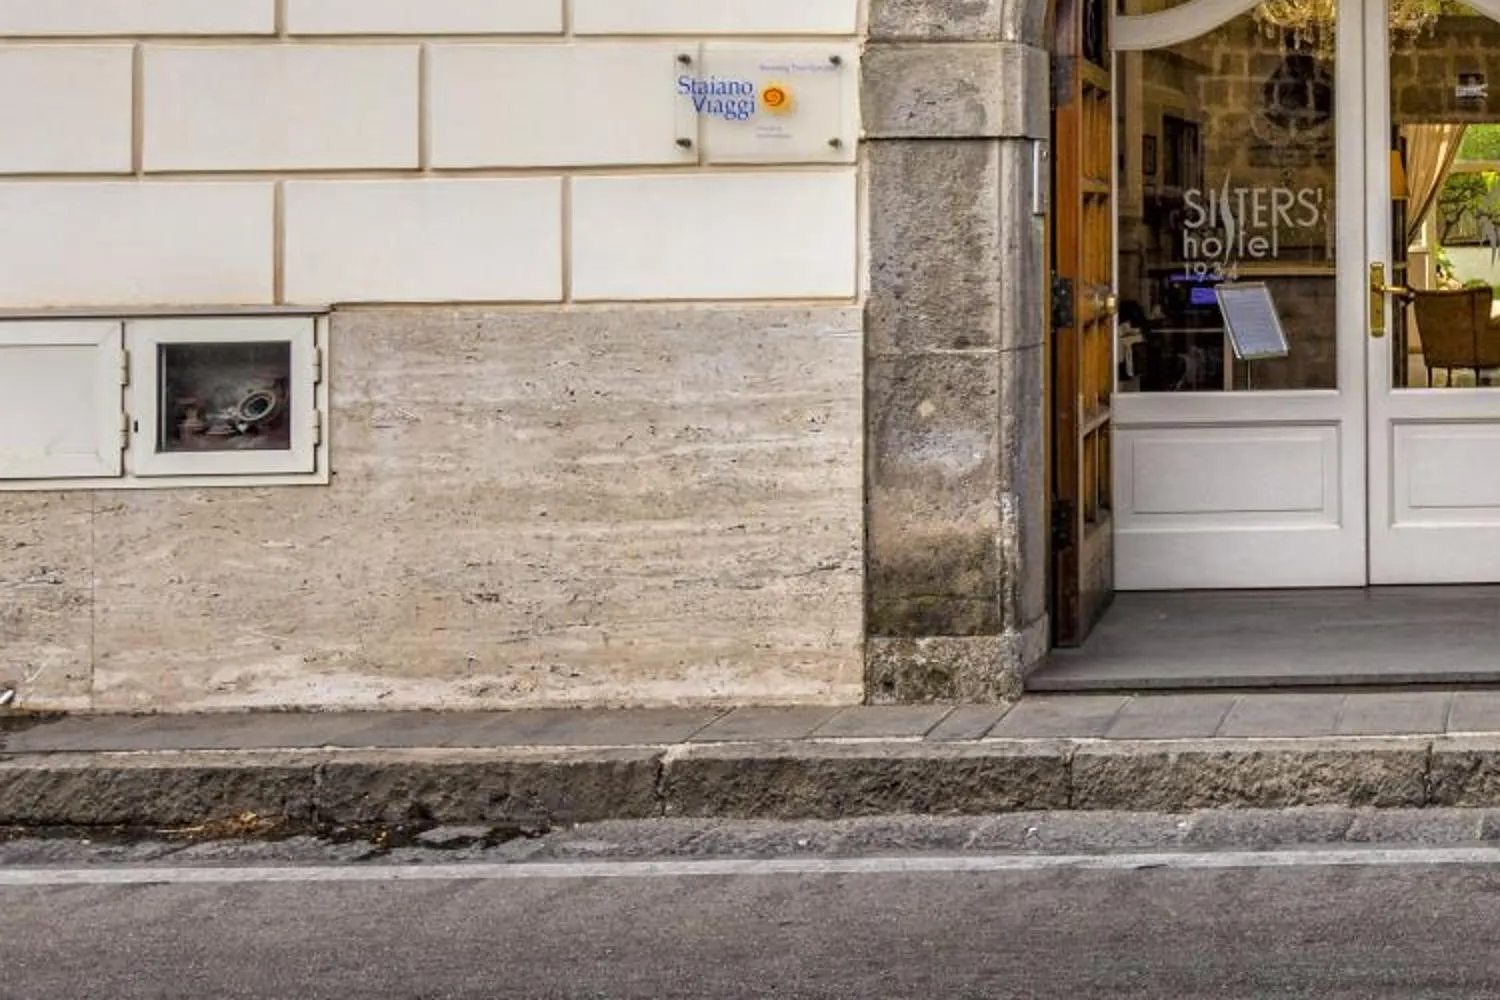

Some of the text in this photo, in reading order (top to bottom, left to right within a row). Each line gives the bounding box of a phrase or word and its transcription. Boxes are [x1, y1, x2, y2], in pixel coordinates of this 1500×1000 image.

[677, 75, 753, 96] Staiano
[692, 96, 755, 121] Viaggi
[1183, 187, 1323, 229] SISTERS'
[1183, 229, 1279, 259] hotel
[1184, 261, 1239, 281] 1934
